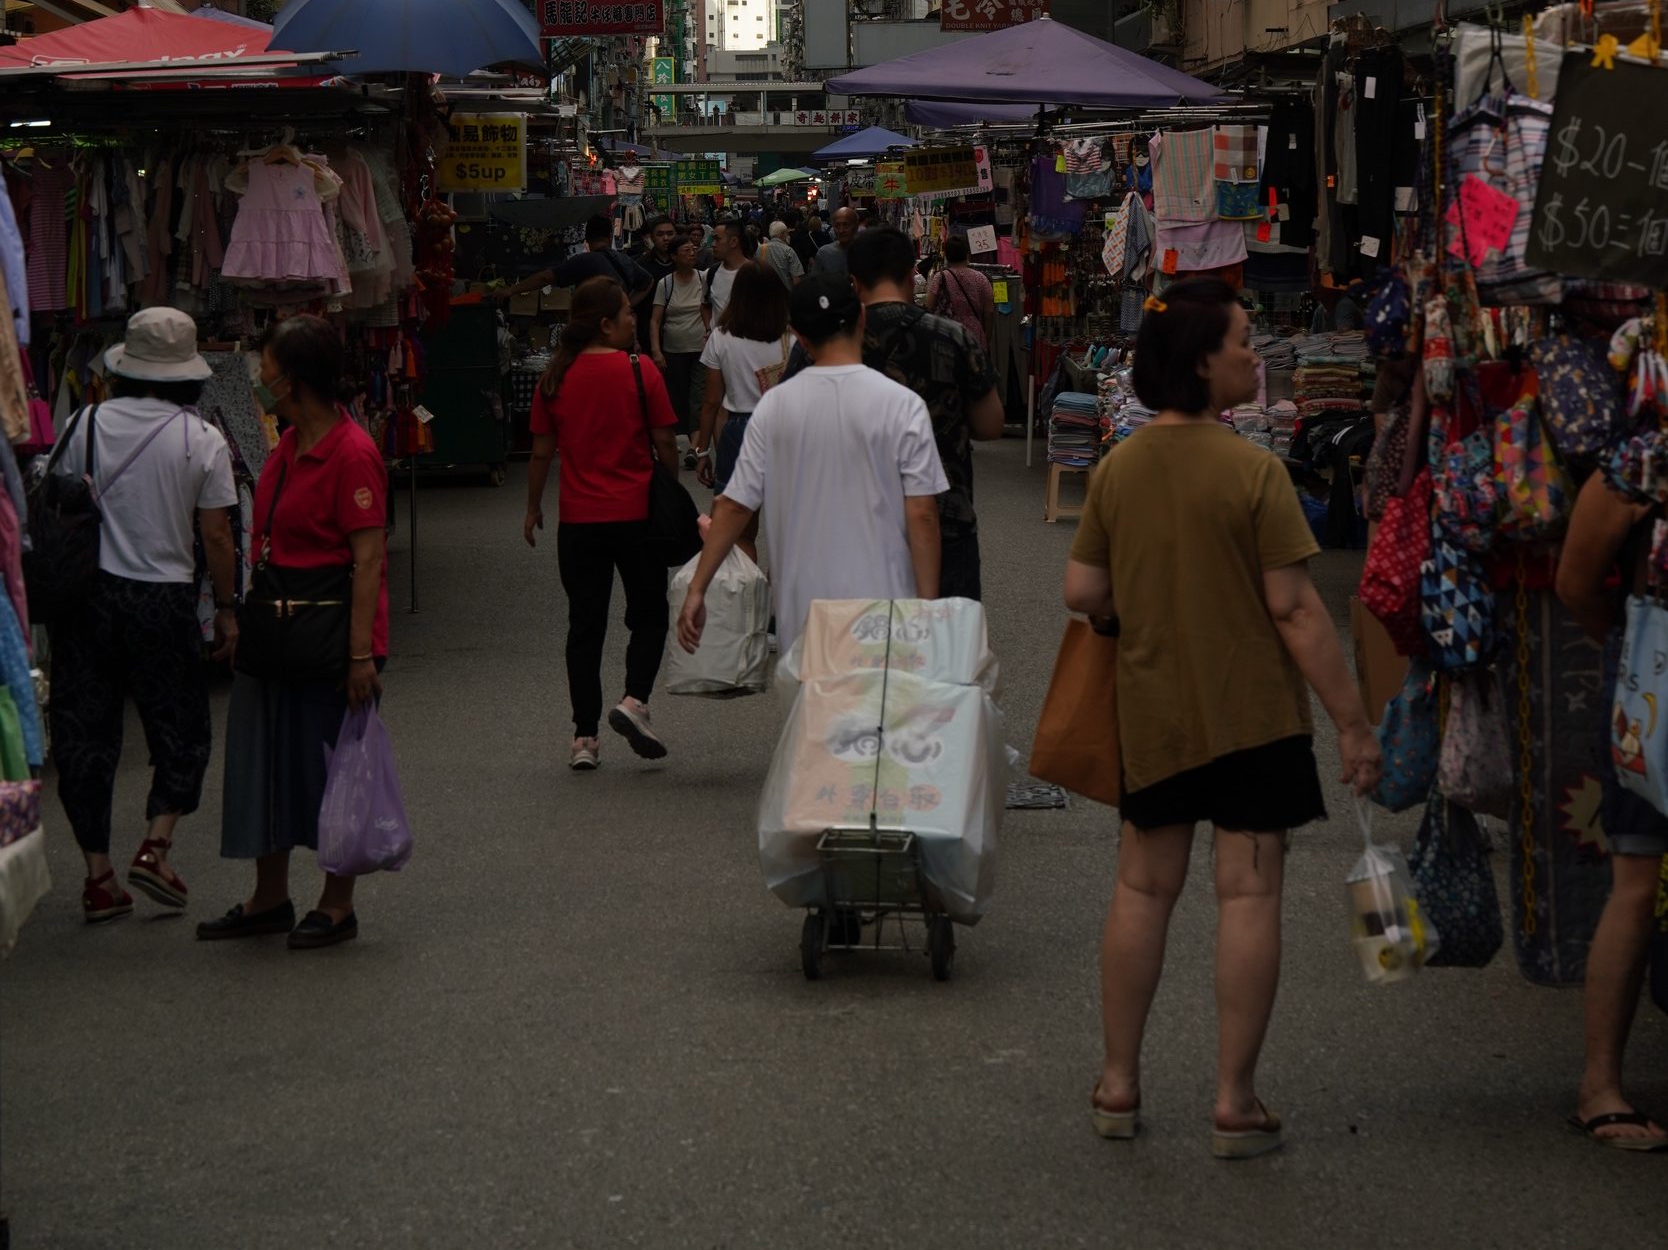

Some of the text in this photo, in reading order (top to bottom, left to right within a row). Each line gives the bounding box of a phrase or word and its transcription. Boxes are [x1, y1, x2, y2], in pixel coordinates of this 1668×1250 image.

[455, 163, 506, 182] $5up
[850, 173, 875, 189] 皮帶
[883, 178, 900, 192] 牛
[975, 240, 990, 251] 35
